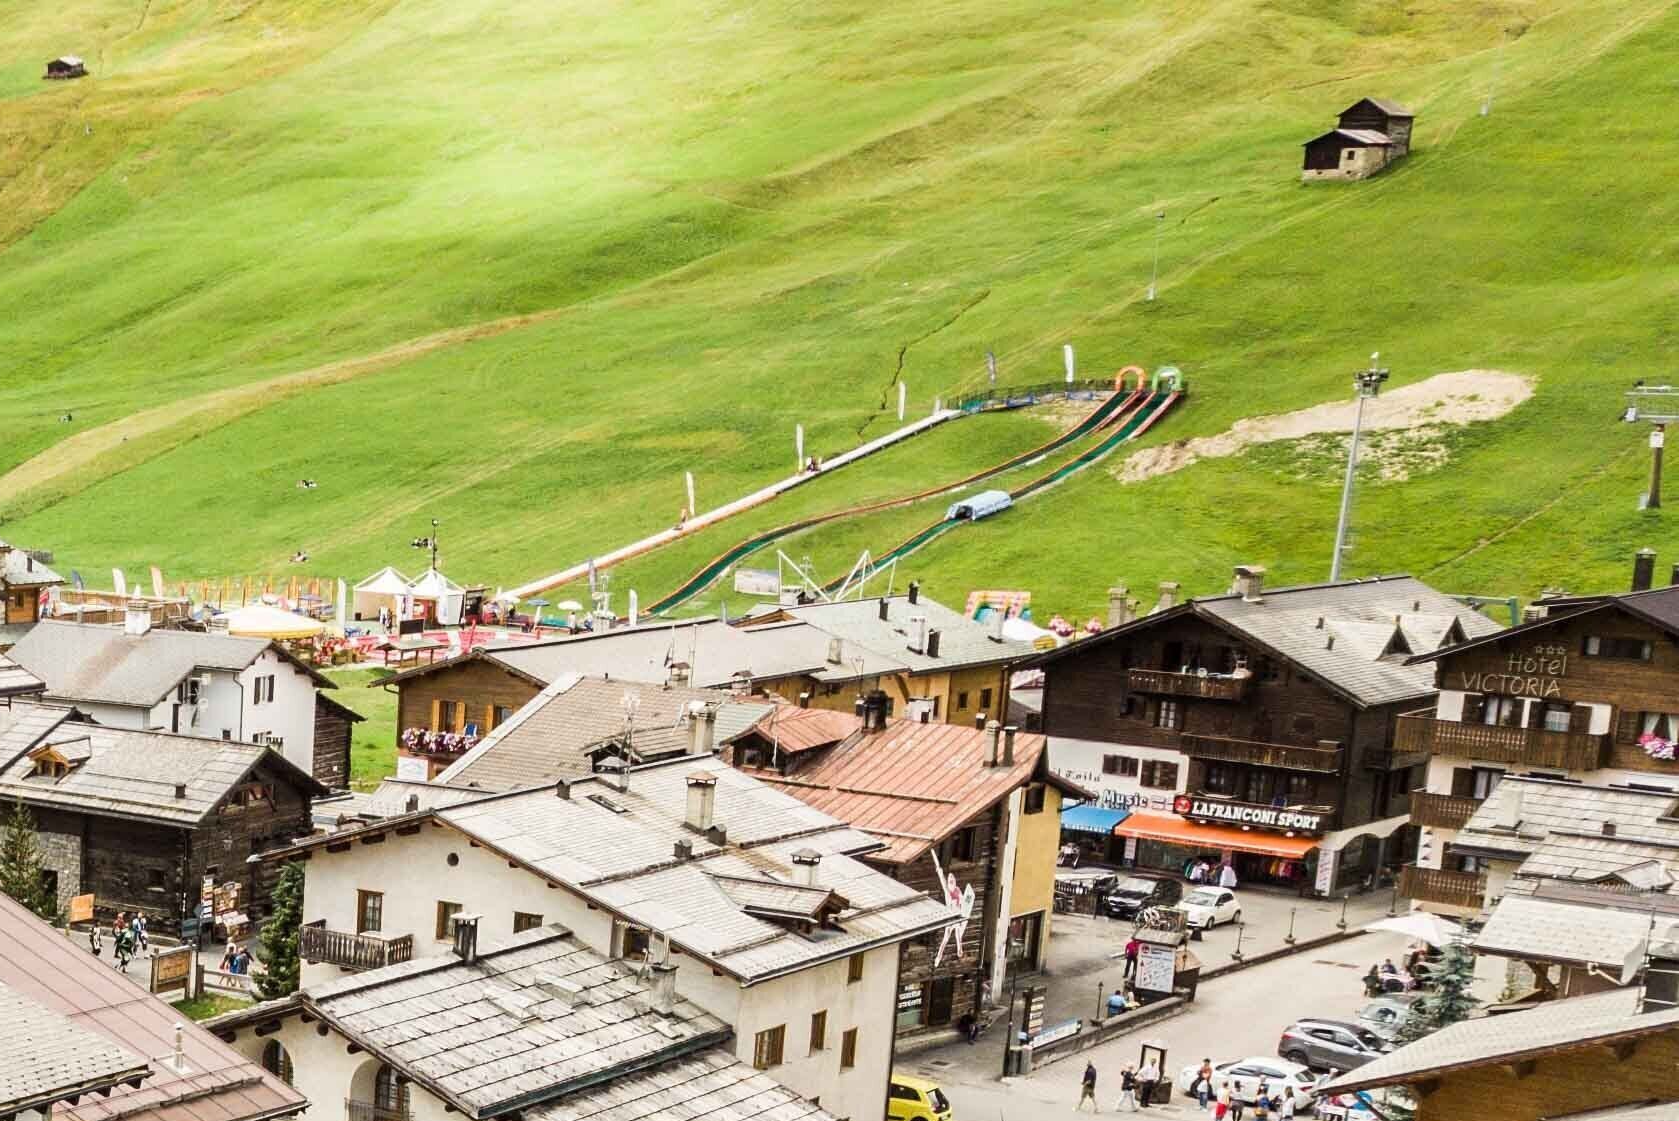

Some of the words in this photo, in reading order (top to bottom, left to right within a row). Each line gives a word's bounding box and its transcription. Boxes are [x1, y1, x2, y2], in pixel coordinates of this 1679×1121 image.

[1508, 653, 1567, 676] Hotel
[1462, 671, 1561, 697] VICTORIA
[1102, 788, 1149, 809] Music
[1191, 801, 1277, 825] LAFRANCONI
[1277, 813, 1320, 830] SPORT
